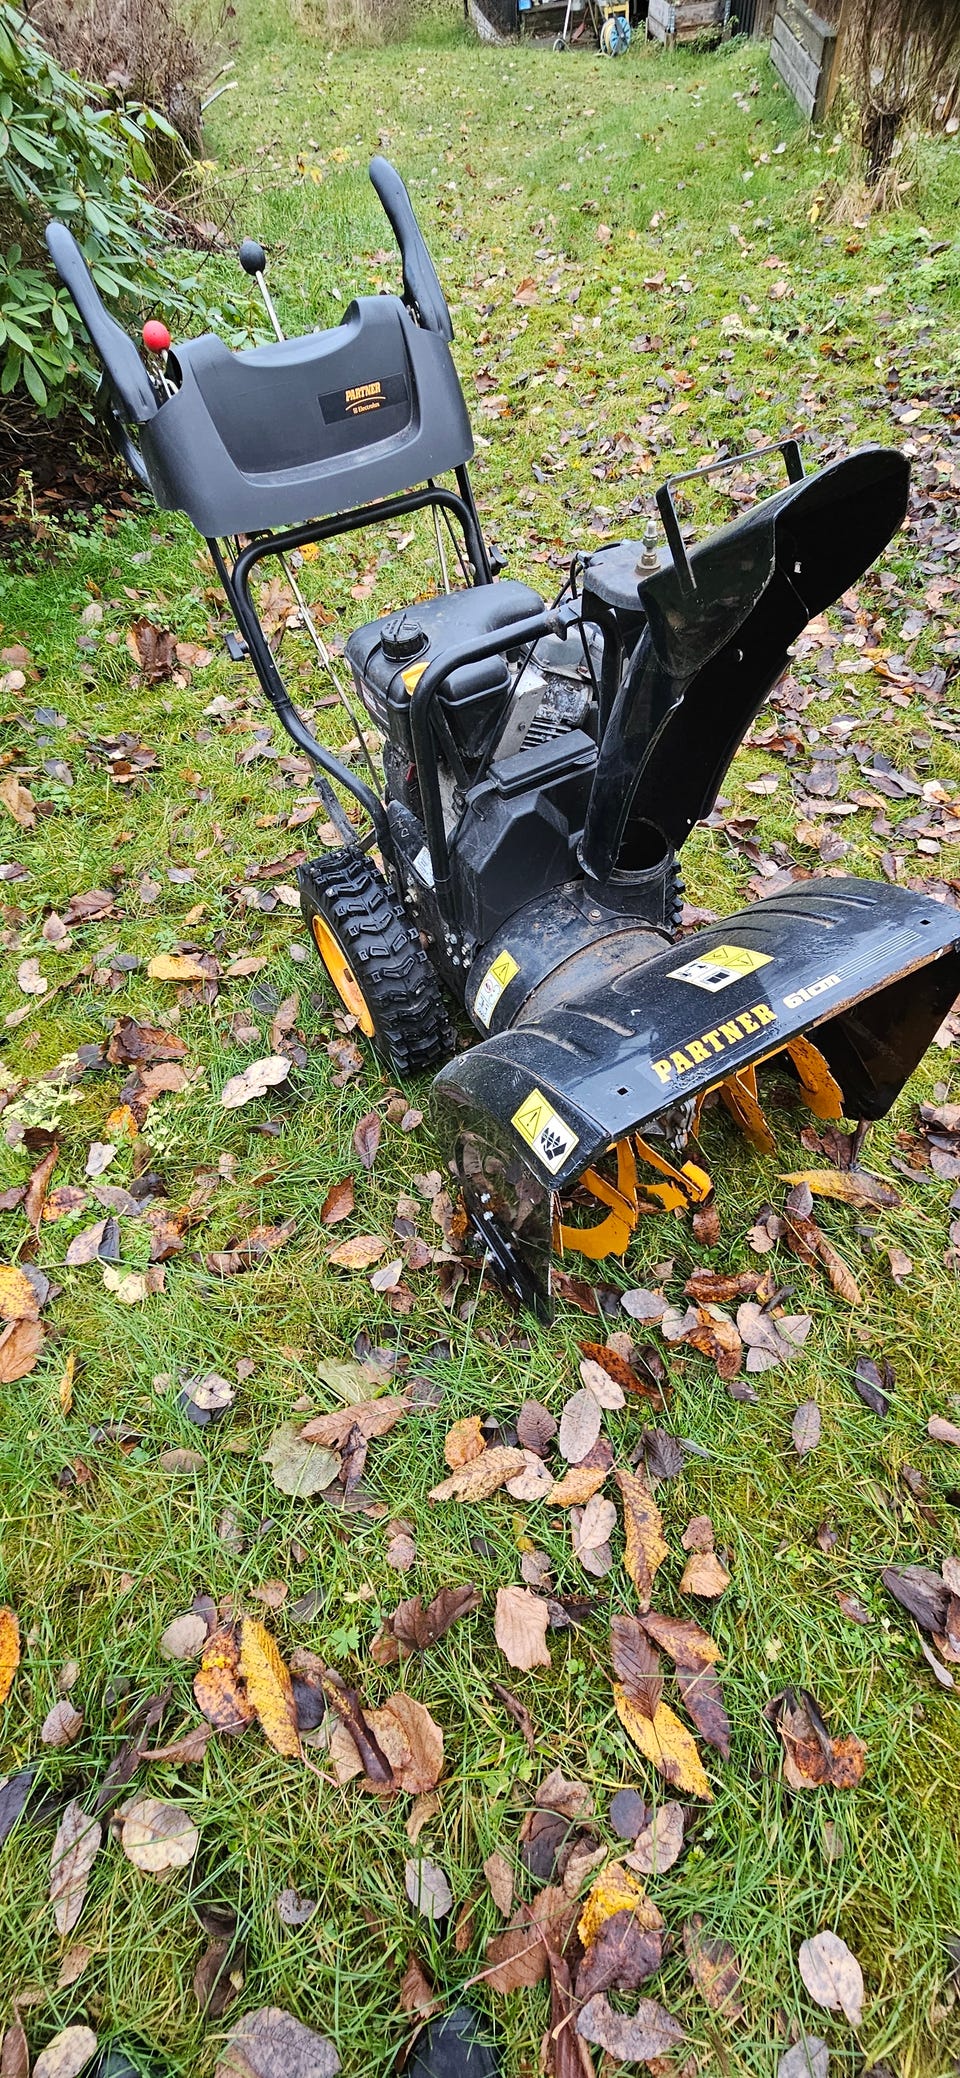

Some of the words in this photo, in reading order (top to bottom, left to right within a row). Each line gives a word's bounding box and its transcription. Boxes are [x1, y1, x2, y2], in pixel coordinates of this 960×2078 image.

[345, 381, 381, 402] PARTNER
[358, 402, 380, 412] Electrolux
[651, 1003, 778, 1084] PARTNER
